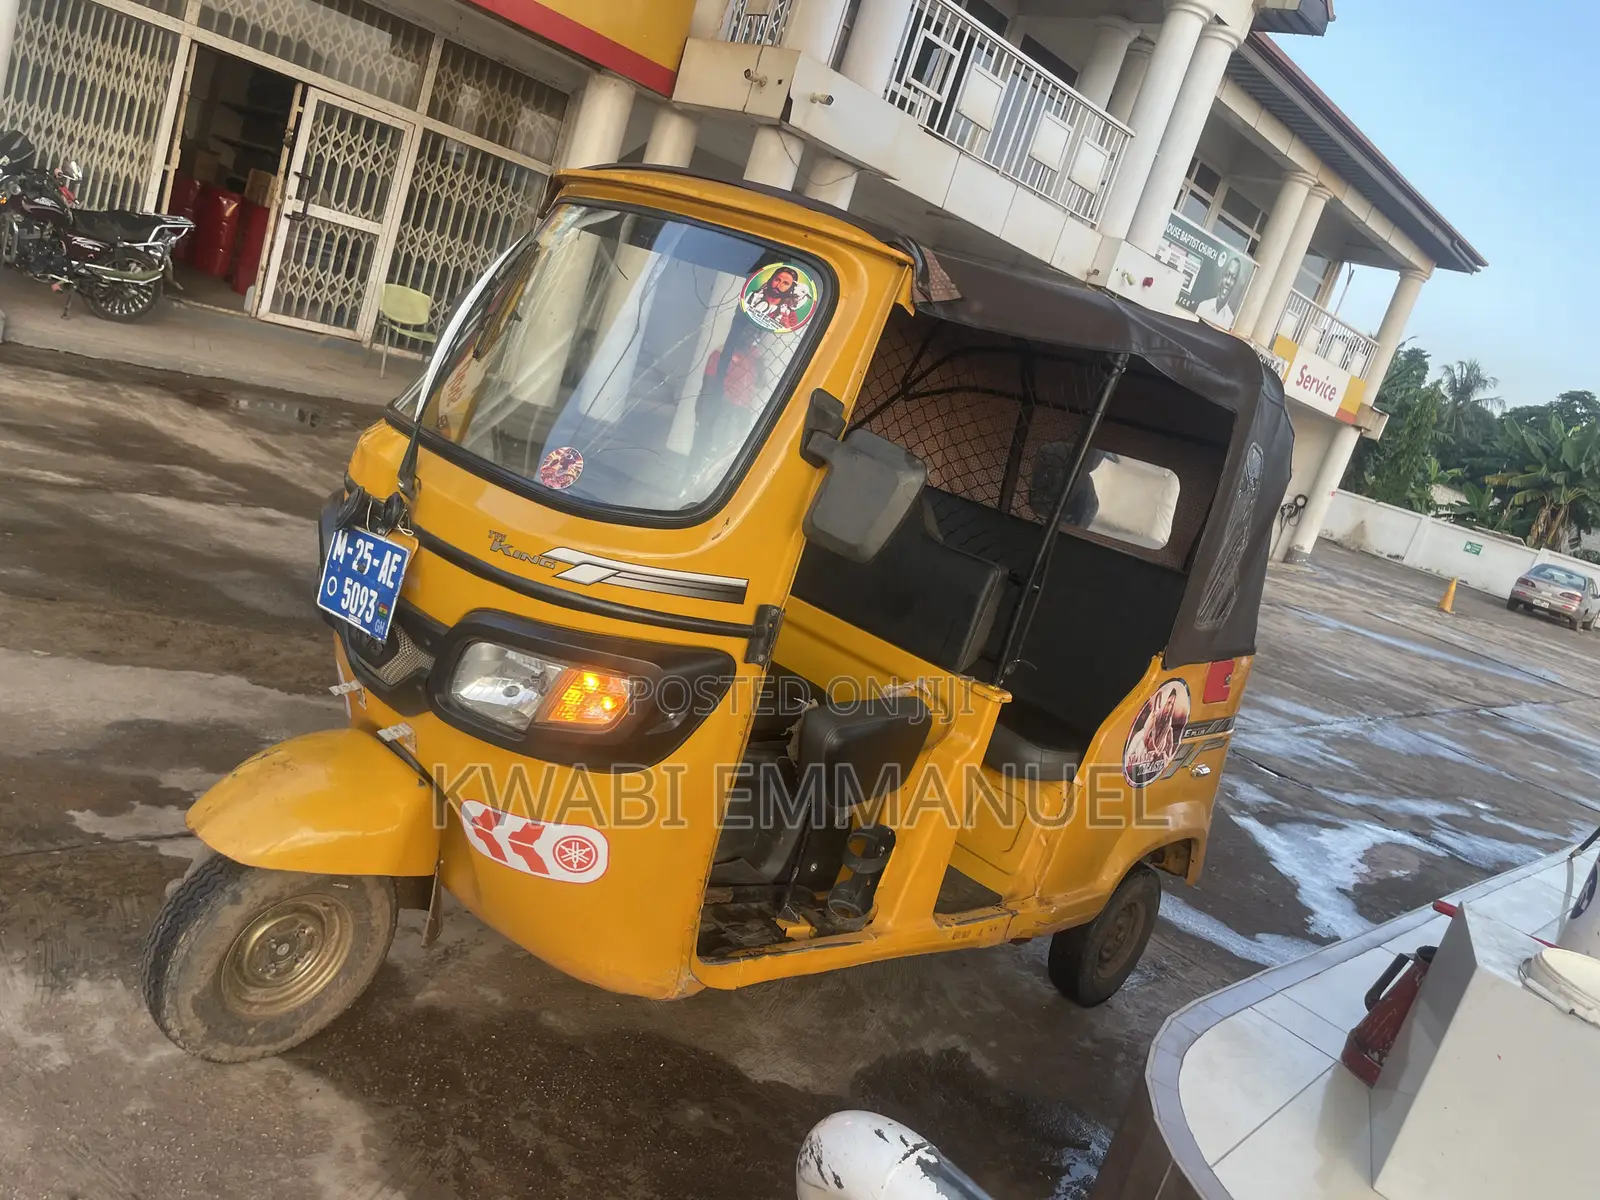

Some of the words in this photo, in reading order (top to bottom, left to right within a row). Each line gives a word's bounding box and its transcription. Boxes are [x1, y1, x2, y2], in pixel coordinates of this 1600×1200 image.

[1166, 222, 1181, 238] OUSE
[1180, 231, 1200, 250] BAPTIST
[1198, 242, 1218, 260] CHURCH
[1295, 364, 1337, 402] Service
[332, 529, 402, 589] M-25-AE
[490, 541, 557, 570] KING
[340, 576, 378, 624] 5093
[374, 618, 387, 635] GH
